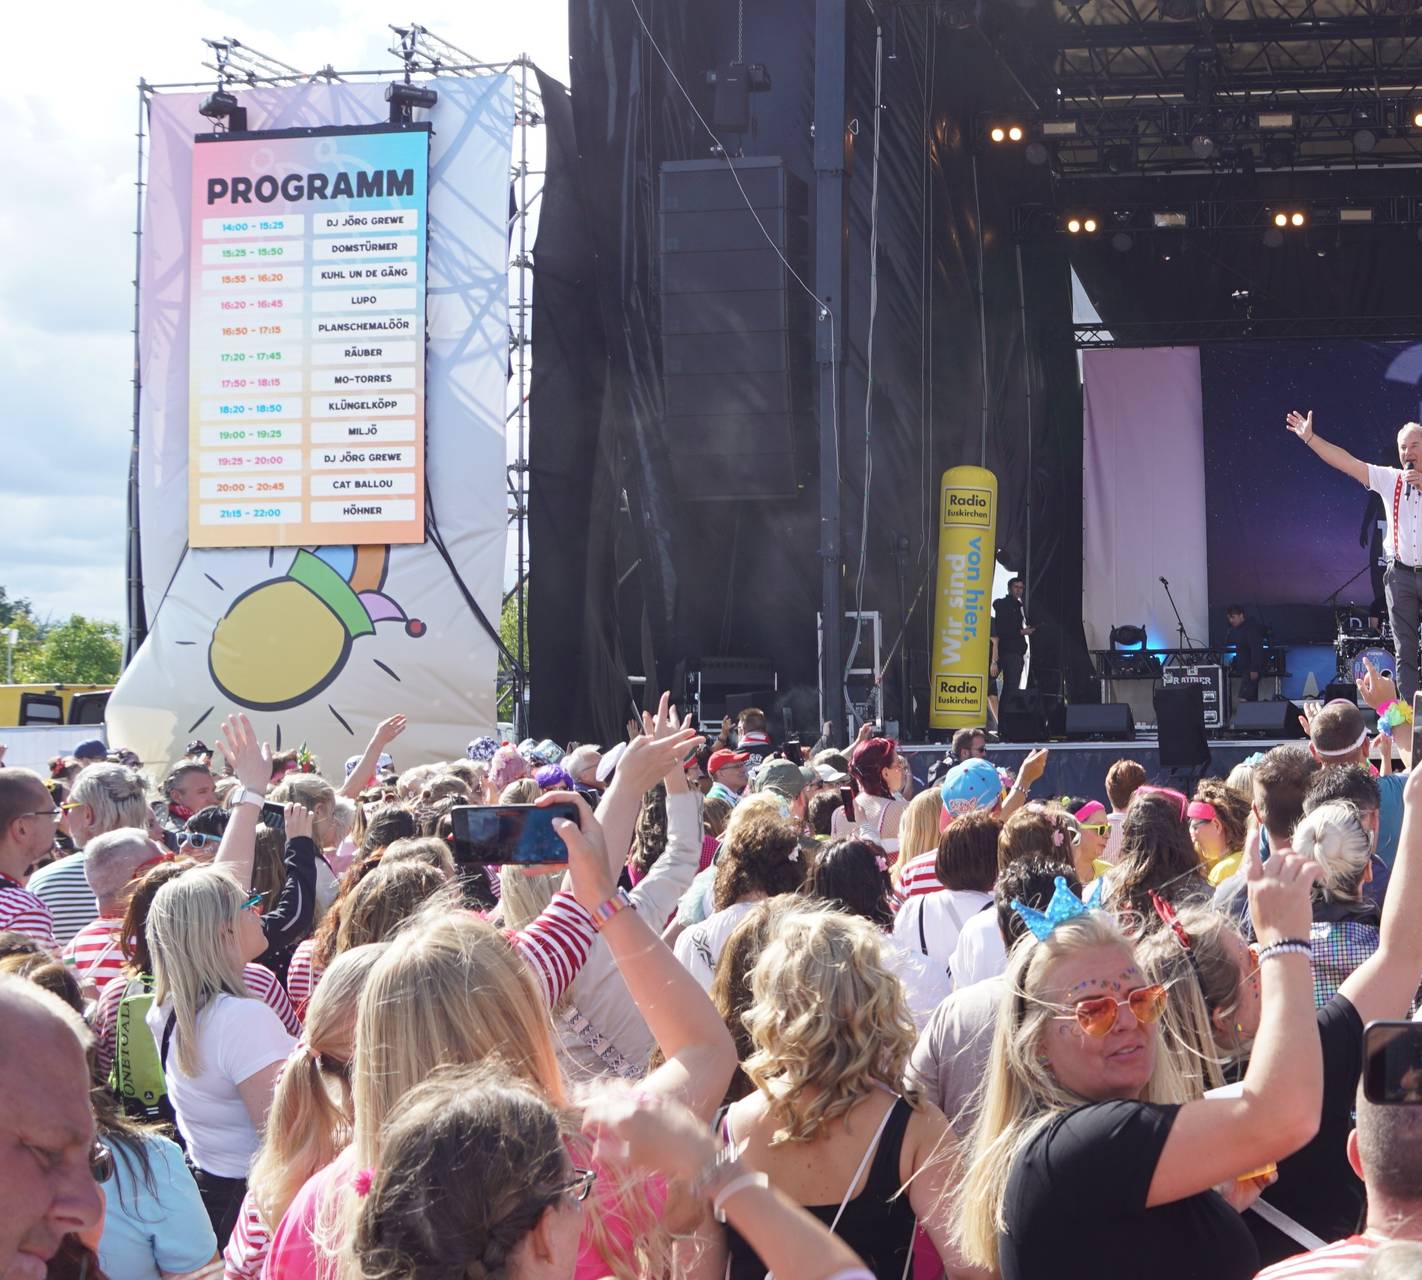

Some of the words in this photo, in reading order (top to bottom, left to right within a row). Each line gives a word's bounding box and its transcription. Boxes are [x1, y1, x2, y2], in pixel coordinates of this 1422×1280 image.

[207, 169, 414, 205] PROGRAMM
[223, 223, 248, 231] 14:00
[259, 221, 284, 230] 15:25
[326, 219, 339, 227] DJ
[342, 215, 368, 226] JÖRG
[371, 216, 404, 225] GREWE
[222, 249, 247, 257] 15:25
[258, 247, 284, 256] 15:50
[331, 240, 398, 253] DOMSTÜRMER
[221, 275, 247, 283] 15:55
[257, 273, 284, 282] 16:20
[321, 271, 346, 279] KUHL
[349, 270, 362, 278] UN
[365, 269, 378, 278] DE
[381, 266, 408, 277] GÄNG
[221, 301, 246, 310] 16:20
[257, 299, 283, 308] 16:45
[351, 296, 377, 304] LUPO
[222, 327, 248, 336] 16:50
[259, 326, 281, 334] 17:15
[318, 318, 410, 332] PLANSCHEMALÖÖR
[221, 353, 246, 361] 17:20
[257, 352, 282, 360] 17:45
[344, 346, 383, 357] RÄUBER
[221, 379, 247, 388] 17:50
[257, 378, 281, 386] 18:15
[334, 374, 392, 384] MO-TORRES
[219, 405, 245, 414] 18:20
[256, 404, 282, 412] 18:50
[328, 398, 398, 410] KLÜNGELKÖPP
[219, 431, 246, 439] 19:00
[257, 430, 282, 438] 19:25
[348, 424, 378, 435] MILJÖ
[218, 457, 243, 466] 19:25
[254, 456, 283, 465] 20:00
[324, 455, 336, 463] DJ
[340, 451, 365, 462] JÖRG
[369, 453, 402, 462] GREWE
[217, 483, 245, 492] 20:00
[256, 482, 284, 491] 20:45
[333, 481, 351, 489] CAT
[354, 480, 393, 488] BALLOU
[950, 494, 986, 507] Radio
[220, 510, 242, 518] 21:15
[253, 509, 281, 517] 22:00
[343, 504, 382, 515] HÖHNER
[967, 536, 982, 581] von
[944, 554, 965, 608] sind
[963, 589, 985, 641] hier.
[941, 616, 962, 666] Wir
[940, 681, 977, 694] Radio
